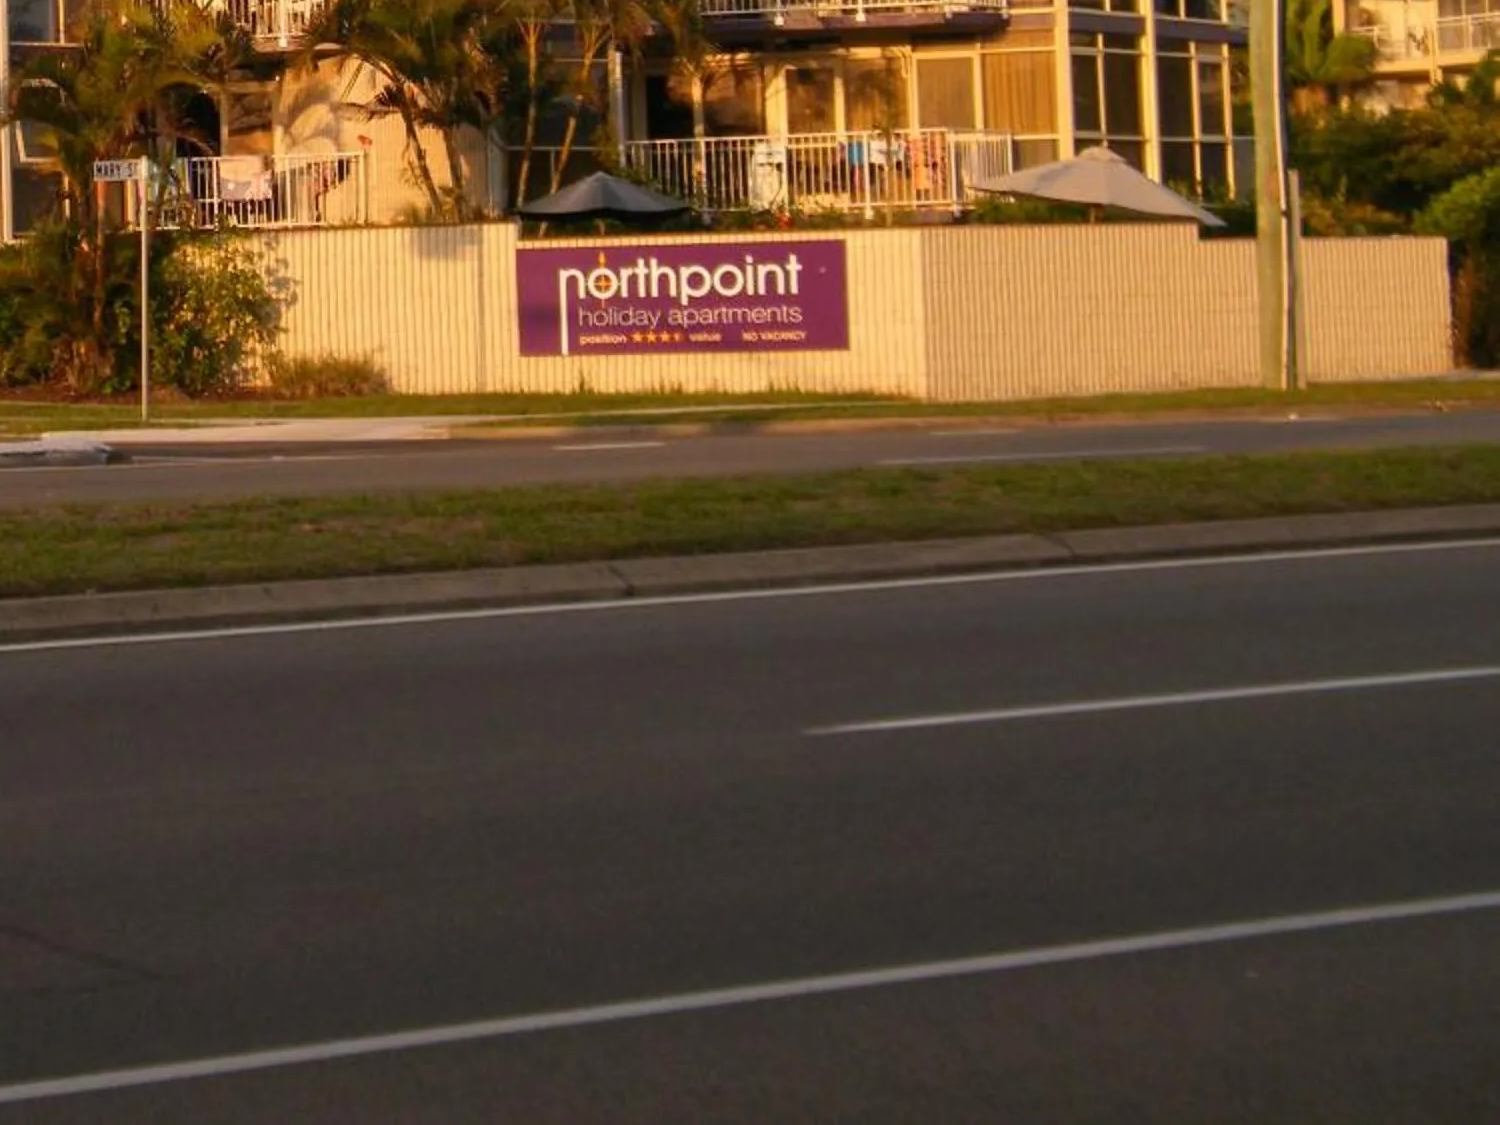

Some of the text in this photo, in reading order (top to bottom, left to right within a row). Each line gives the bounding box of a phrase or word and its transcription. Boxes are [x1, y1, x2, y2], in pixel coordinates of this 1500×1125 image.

[95, 162, 122, 179] MARY
[578, 303, 803, 329] holiday apartments
[579, 332, 627, 345] position
